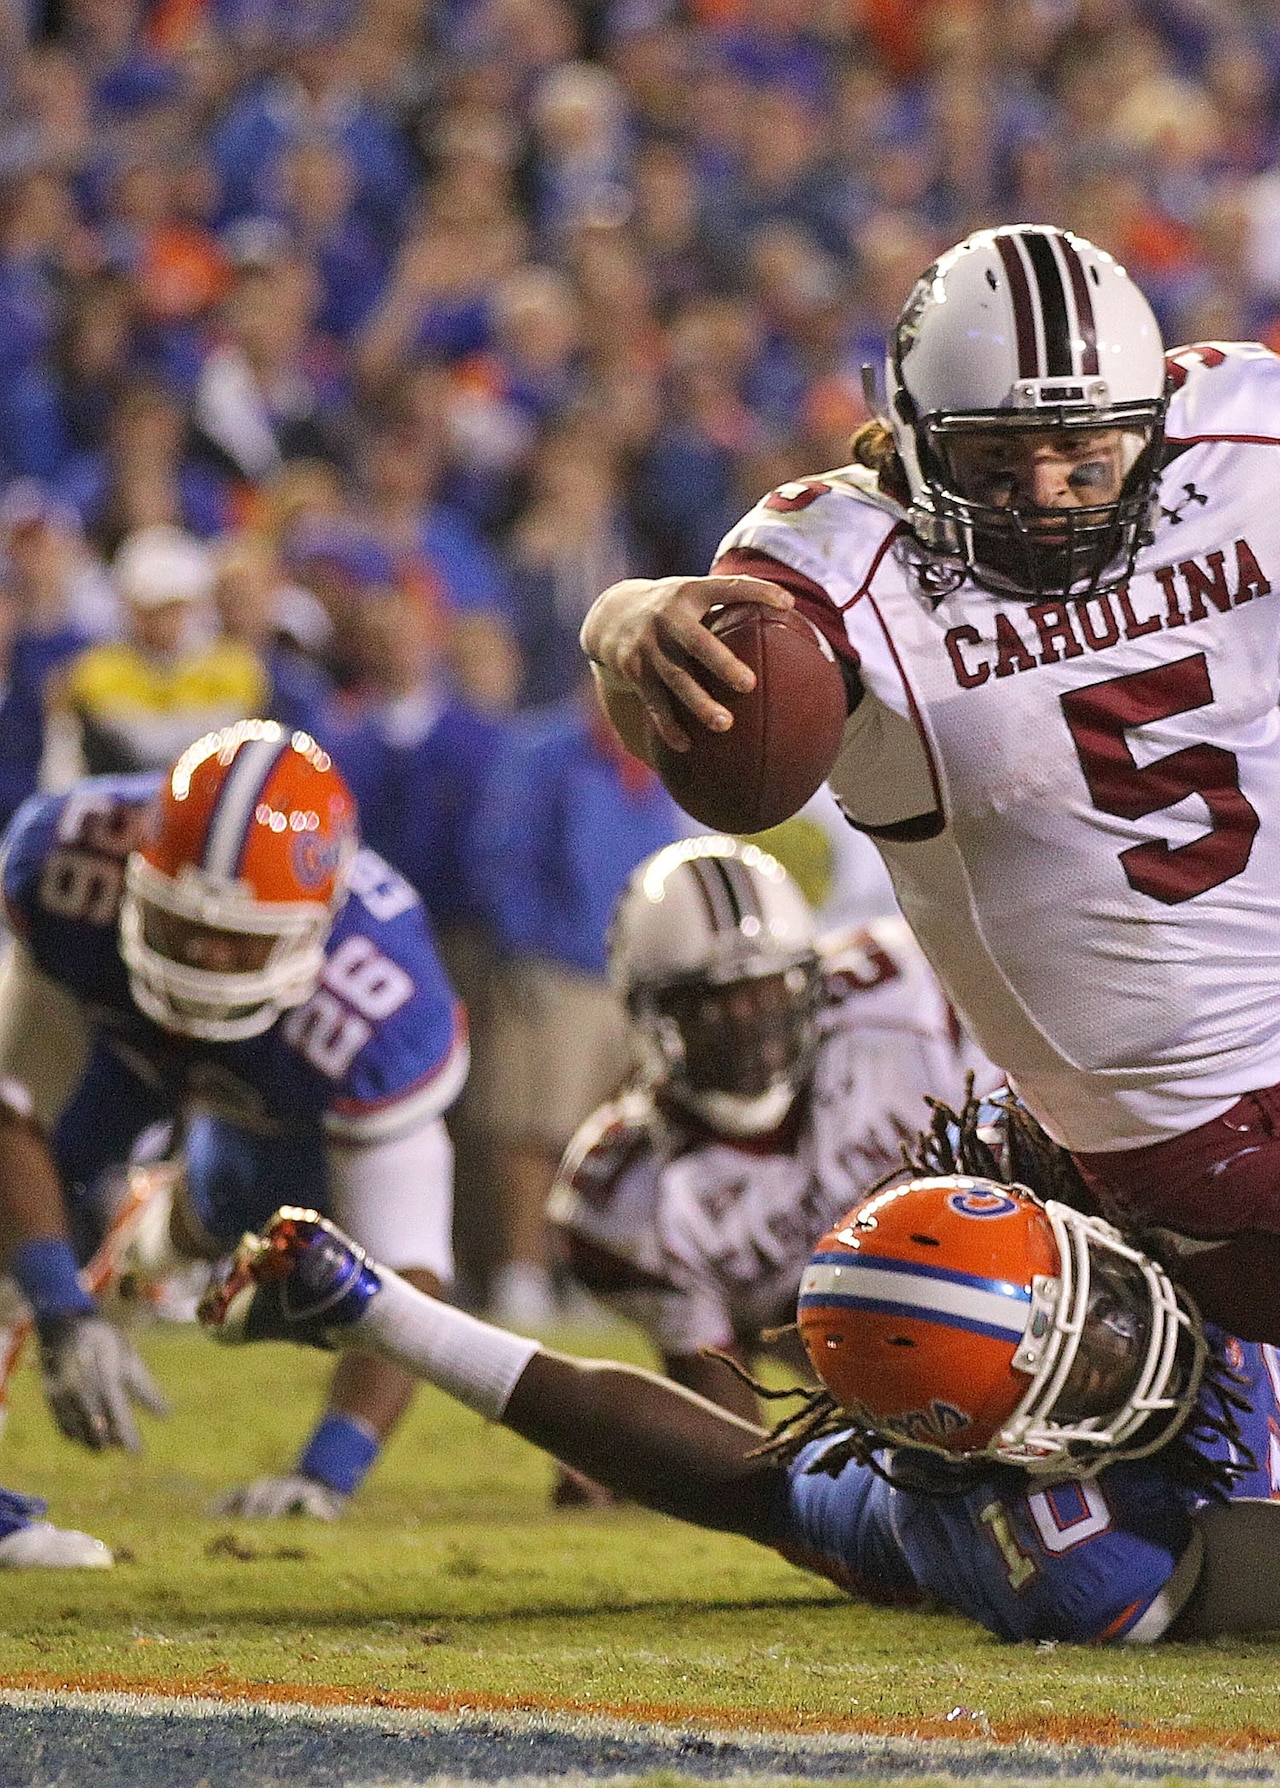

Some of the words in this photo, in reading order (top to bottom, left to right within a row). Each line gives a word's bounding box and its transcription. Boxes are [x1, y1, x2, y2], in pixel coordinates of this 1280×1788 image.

[945, 538, 1271, 689] CAROLINA
[1059, 651, 1261, 905] 5
[979, 1476, 1113, 1591] 10
